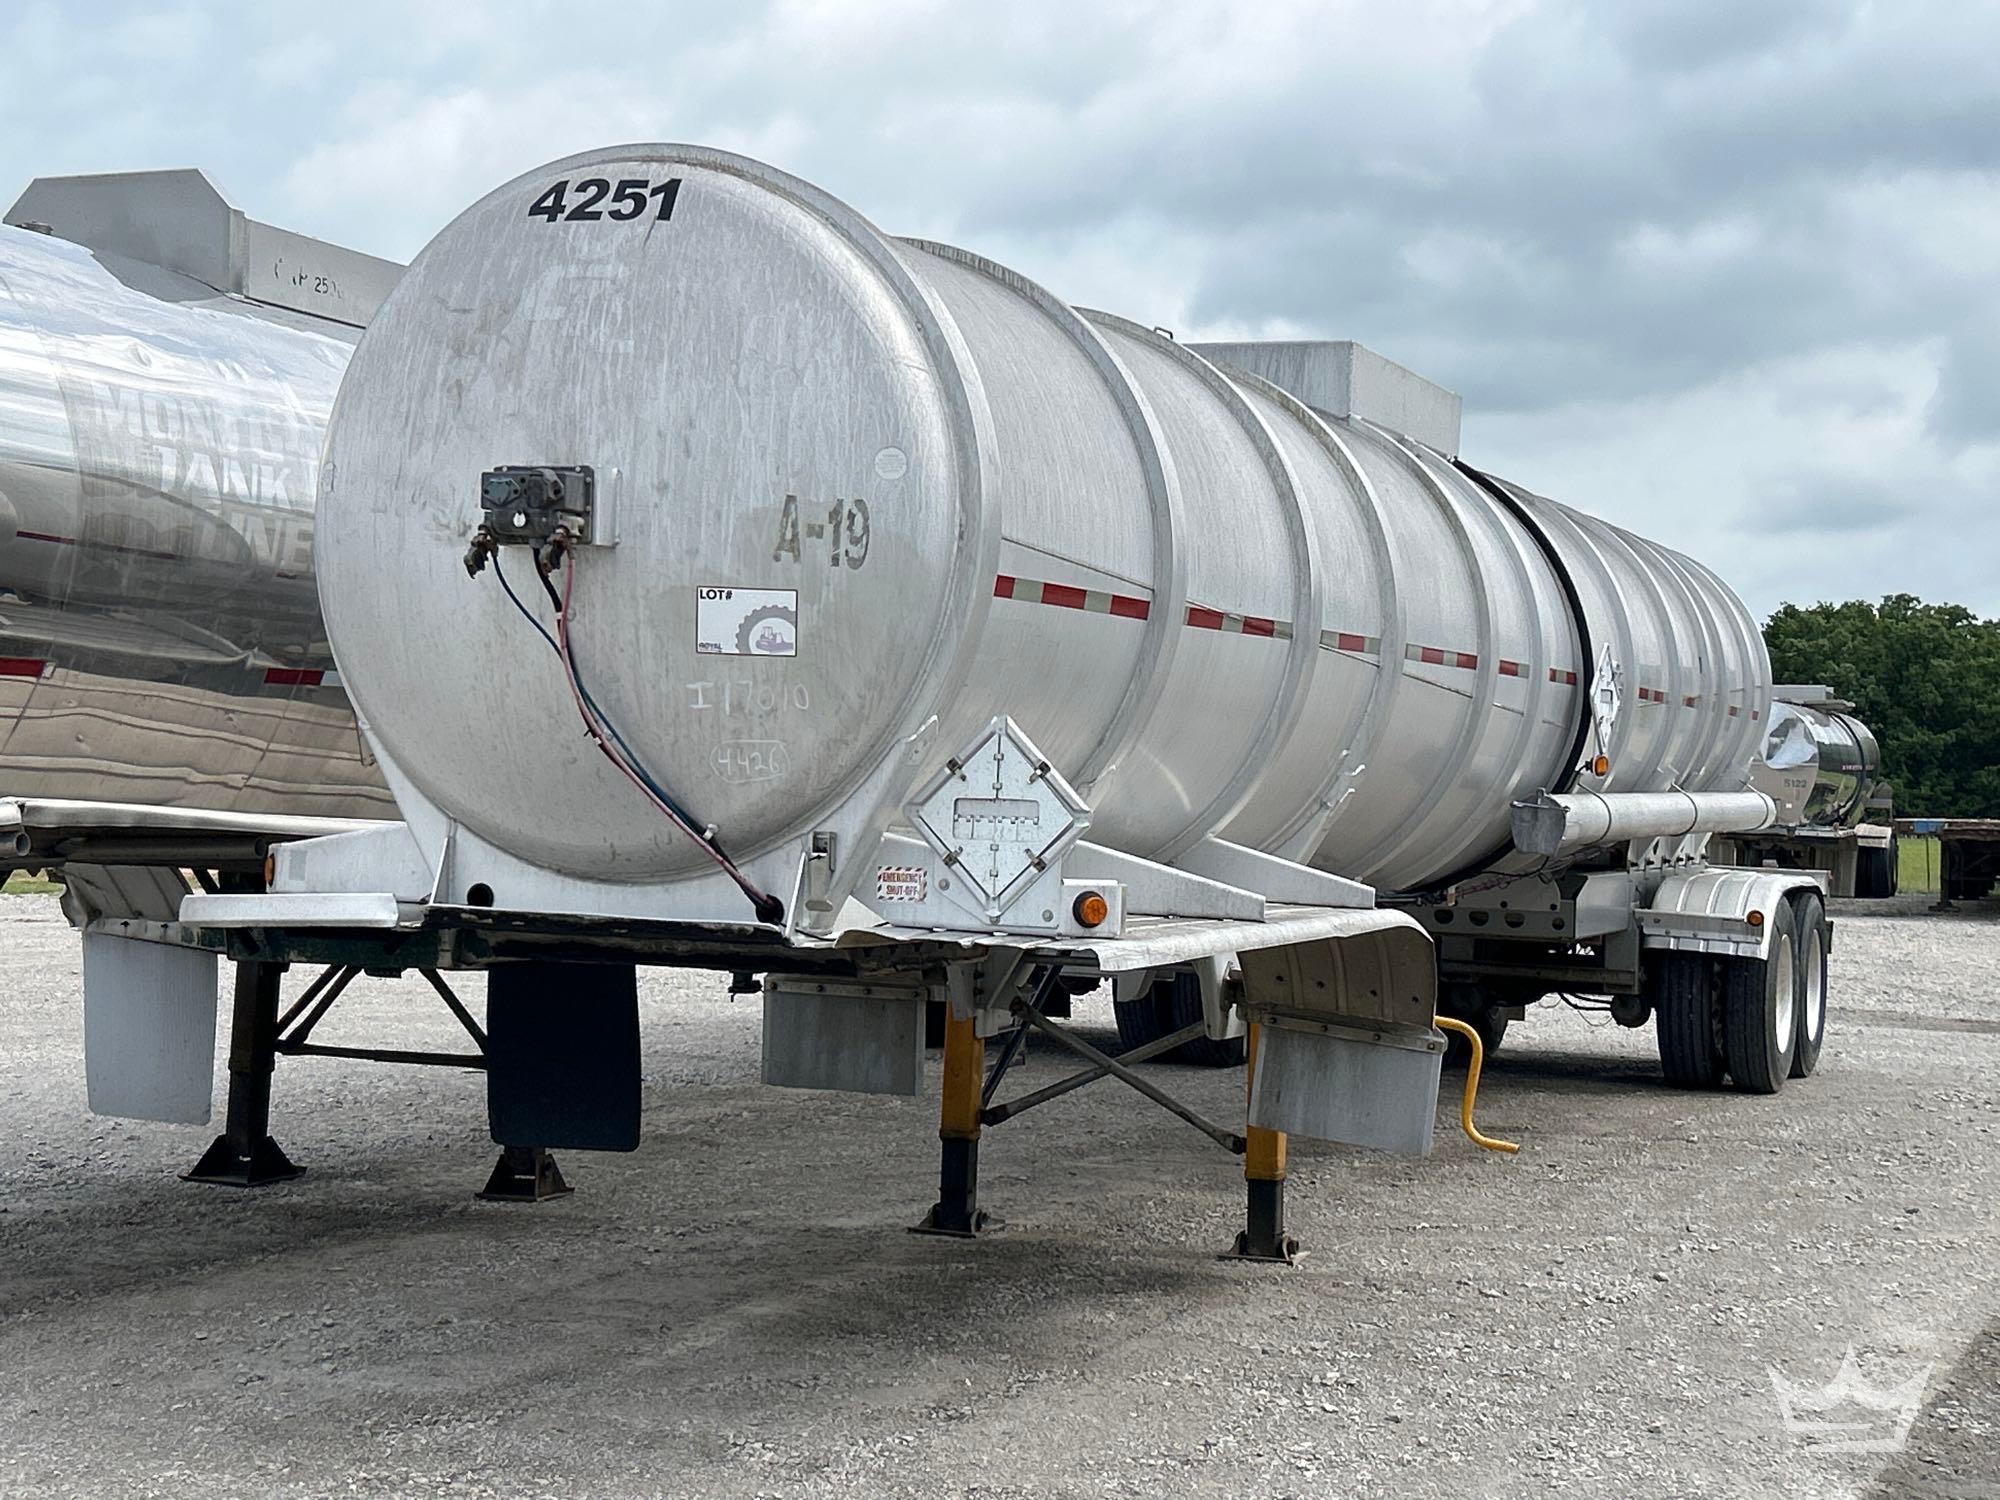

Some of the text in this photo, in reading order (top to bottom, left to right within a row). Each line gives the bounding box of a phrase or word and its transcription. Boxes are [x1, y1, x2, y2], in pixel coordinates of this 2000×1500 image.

[528, 178, 682, 222] 4251
[773, 494, 870, 570] A-19
[699, 589, 733, 601] LOT#
[718, 747, 780, 776] 4426
[882, 872, 922, 883] EMERGENCY
[886, 885, 918, 896] SHUT-OFF
